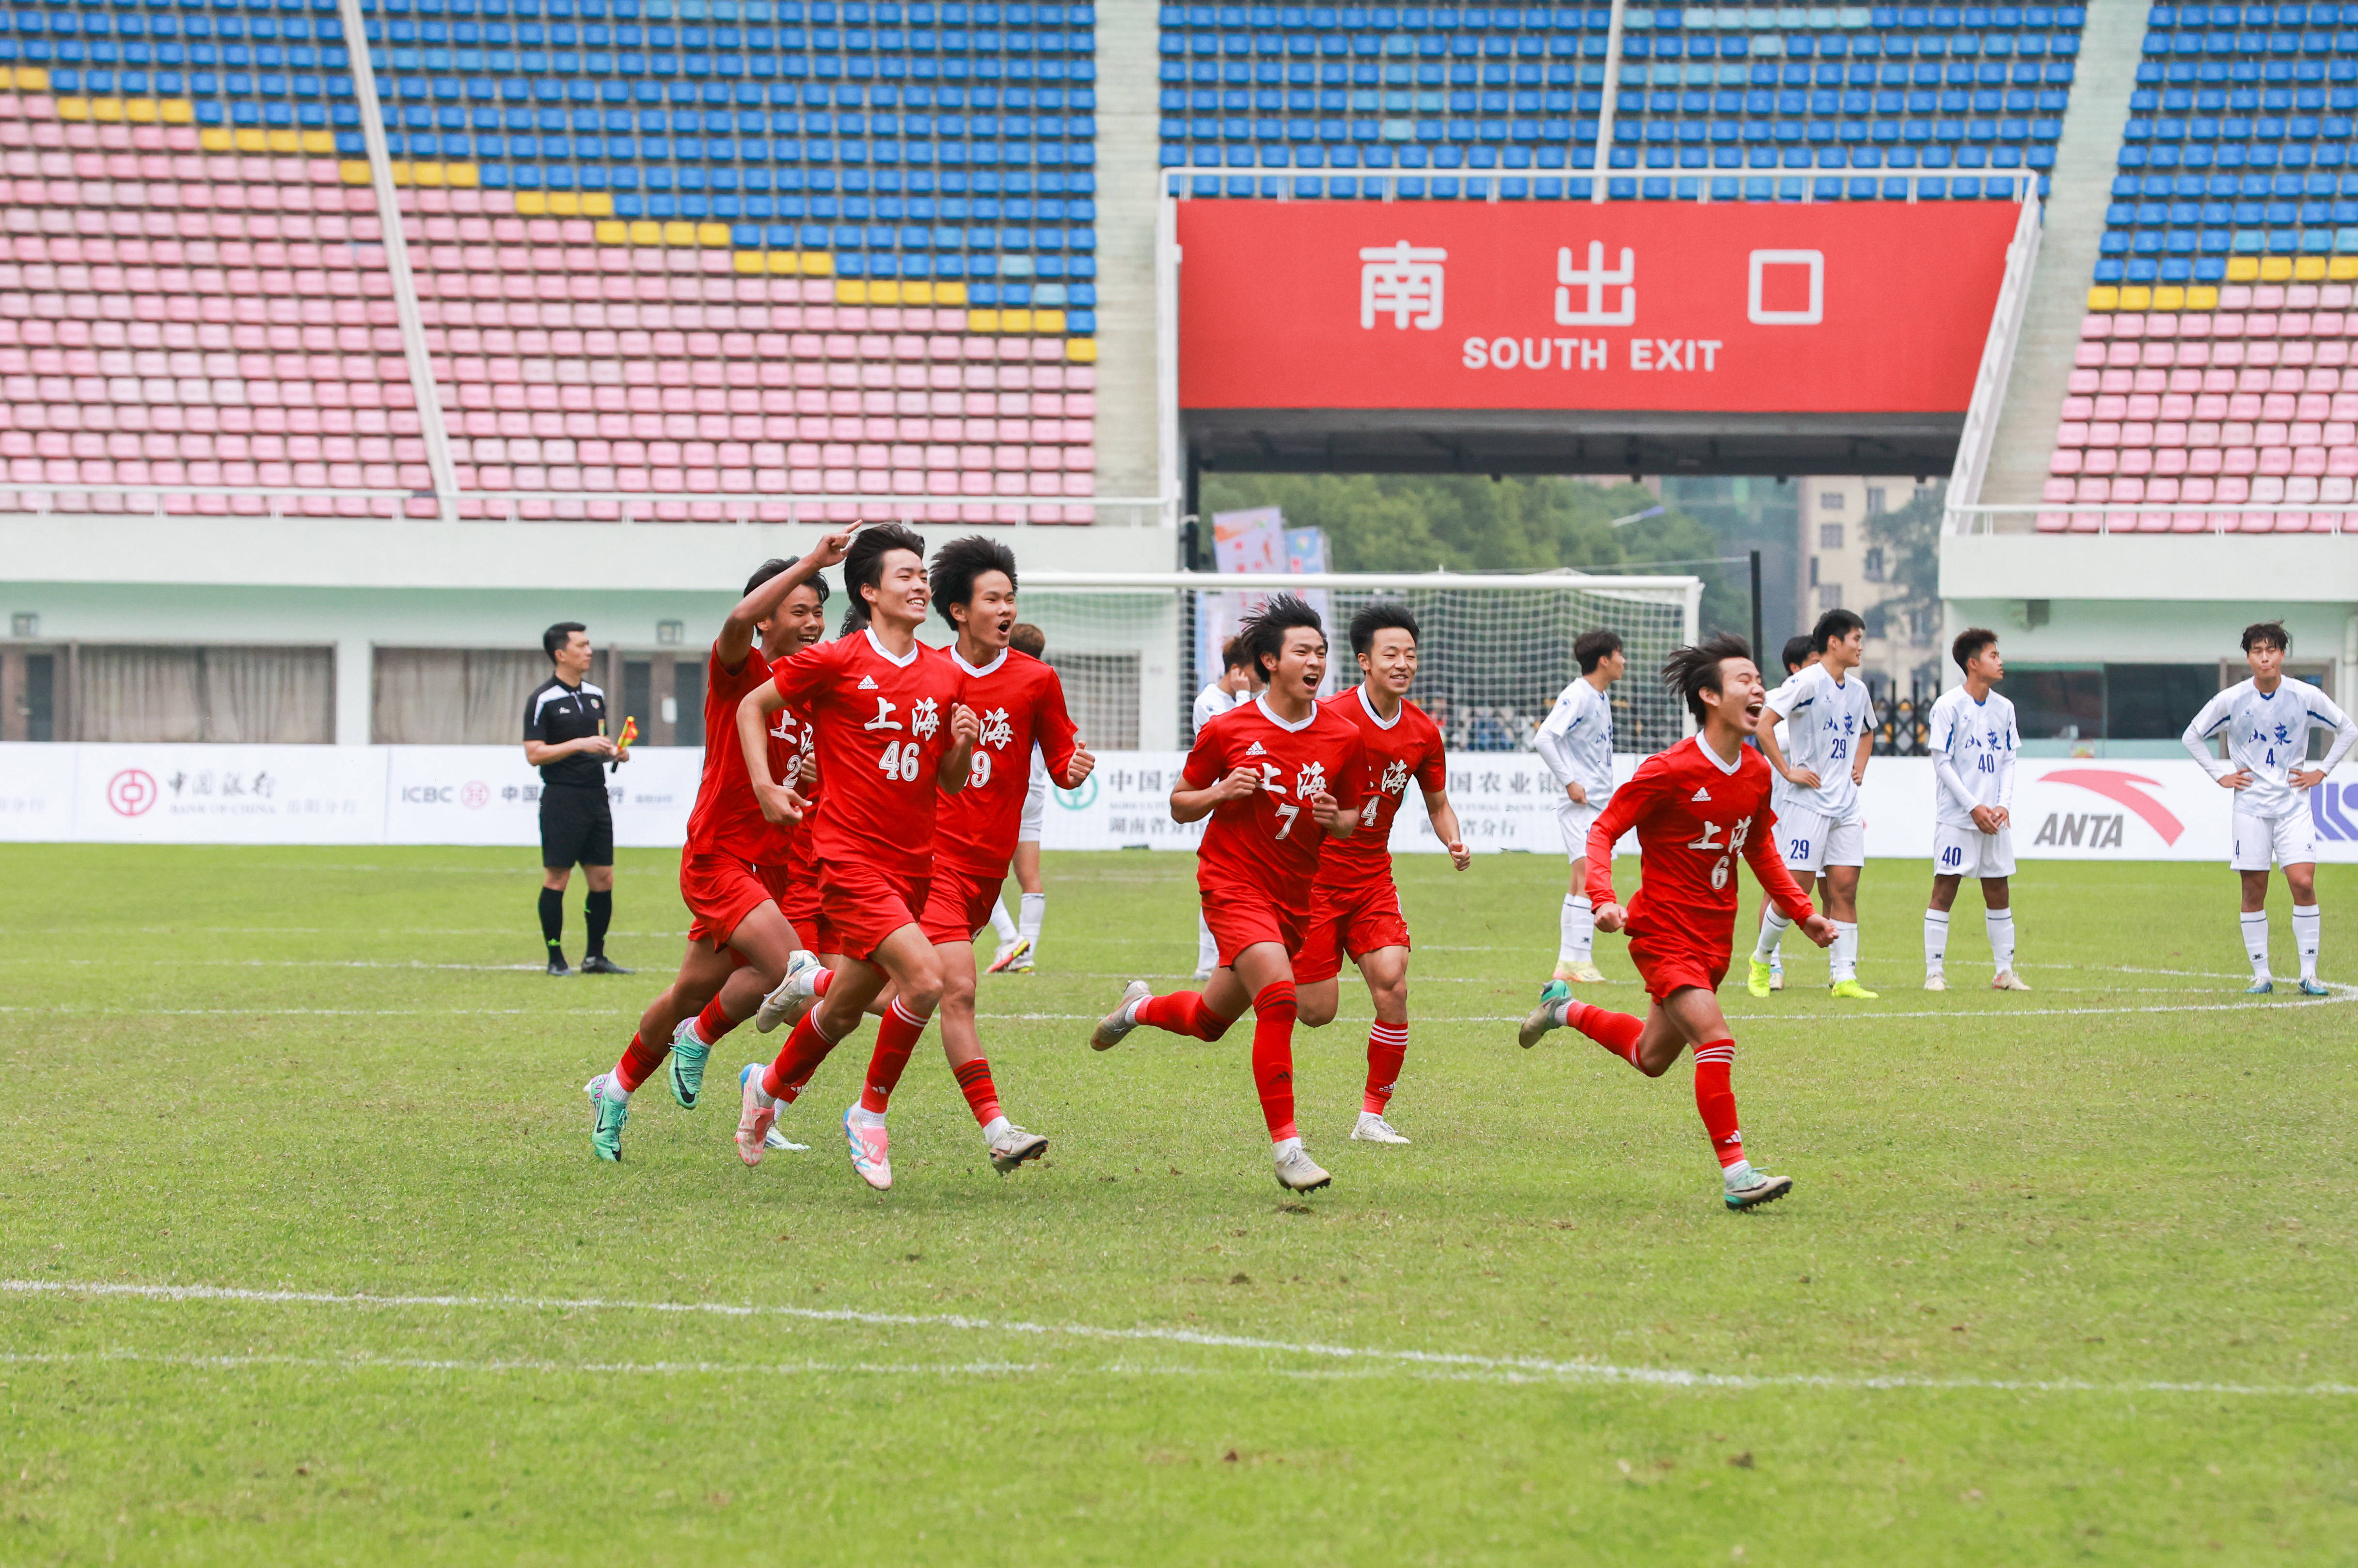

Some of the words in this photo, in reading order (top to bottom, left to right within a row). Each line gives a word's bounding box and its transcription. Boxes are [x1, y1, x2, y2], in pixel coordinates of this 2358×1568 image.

[1359, 240, 1825, 330] 南出口
[1462, 337, 1607, 370] SOUTH
[1630, 338, 1723, 372] EXIT
[864, 696, 940, 741] 上海
[980, 707, 1014, 750] 海
[879, 741, 920, 782] 46
[1831, 738, 1846, 759] 29
[1978, 754, 1994, 774] 40
[2265, 748, 2275, 768] 4
[782, 754, 802, 789] 2
[964, 751, 991, 788] 9
[1258, 761, 1327, 803] 上海
[1368, 759, 1407, 795] 海
[402, 786, 452, 804] ICBC
[1361, 795, 1380, 827] 4
[1275, 802, 1299, 840] 7
[2034, 813, 2123, 848] ANTA
[1790, 839, 1810, 860] 29
[1942, 846, 1962, 866] 40
[1711, 856, 1730, 890] 6
